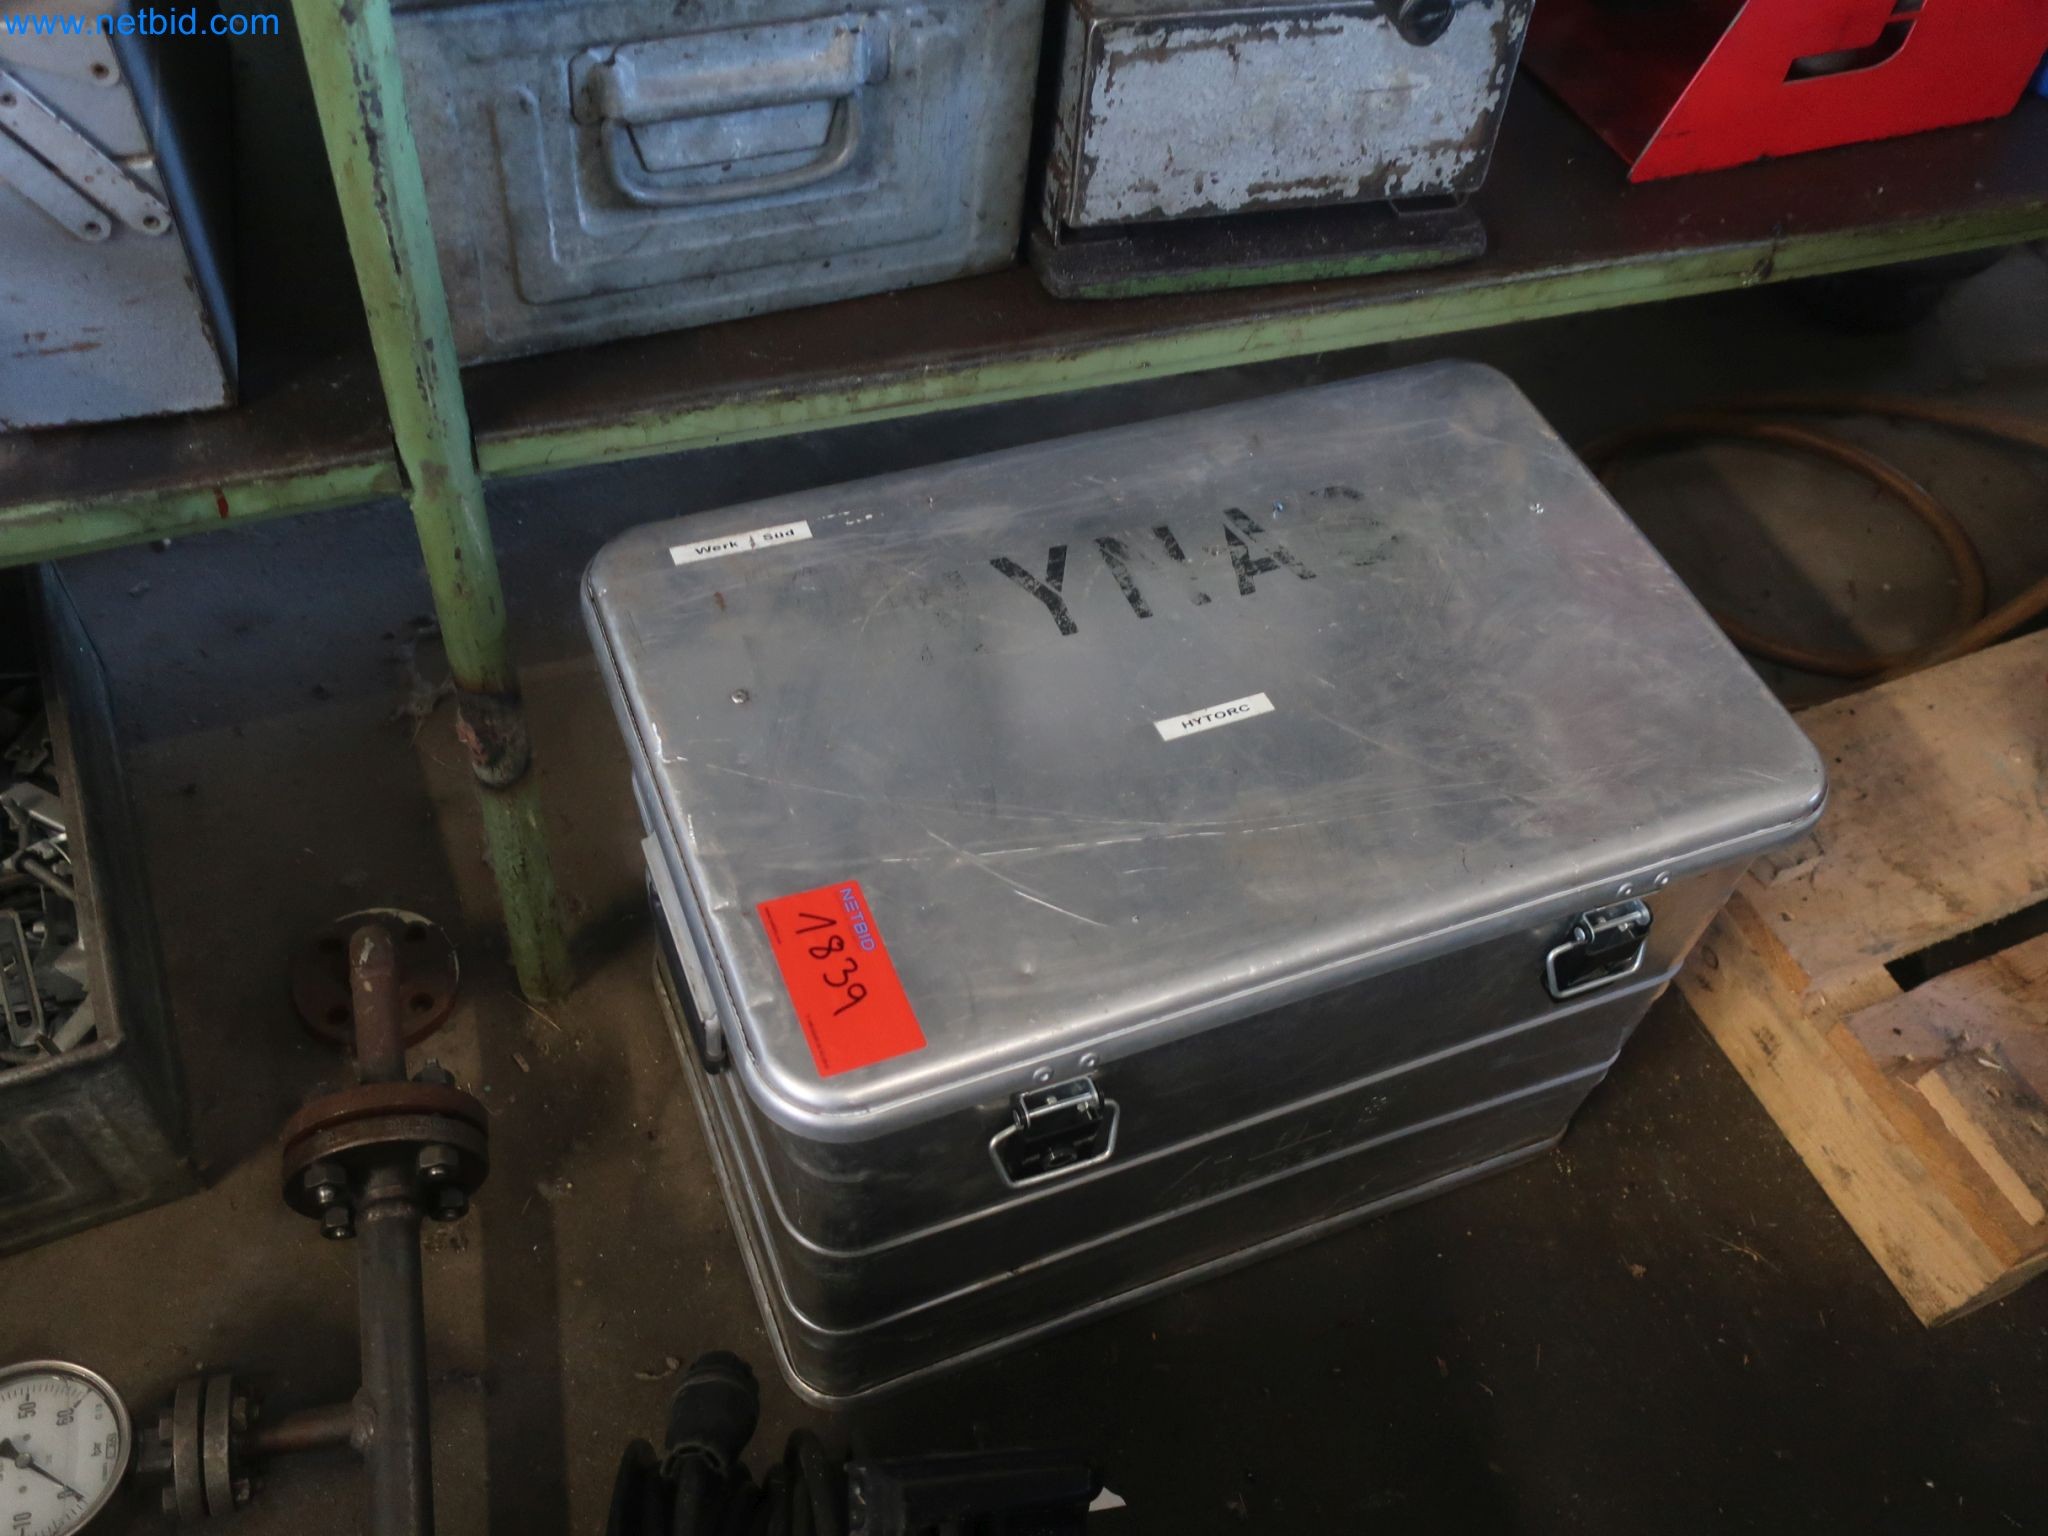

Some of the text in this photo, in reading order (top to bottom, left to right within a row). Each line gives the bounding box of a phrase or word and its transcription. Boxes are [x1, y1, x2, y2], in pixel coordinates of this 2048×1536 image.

[694, 540, 739, 555] Werk
[1181, 704, 1251, 729] HYTORC
[840, 888, 876, 952] NETBID
[795, 912, 867, 1017] 1839
[18, 1401, 37, 1420] 50
[56, 1408, 75, 1426] 60
[12, 1512, 33, 1530] 10
